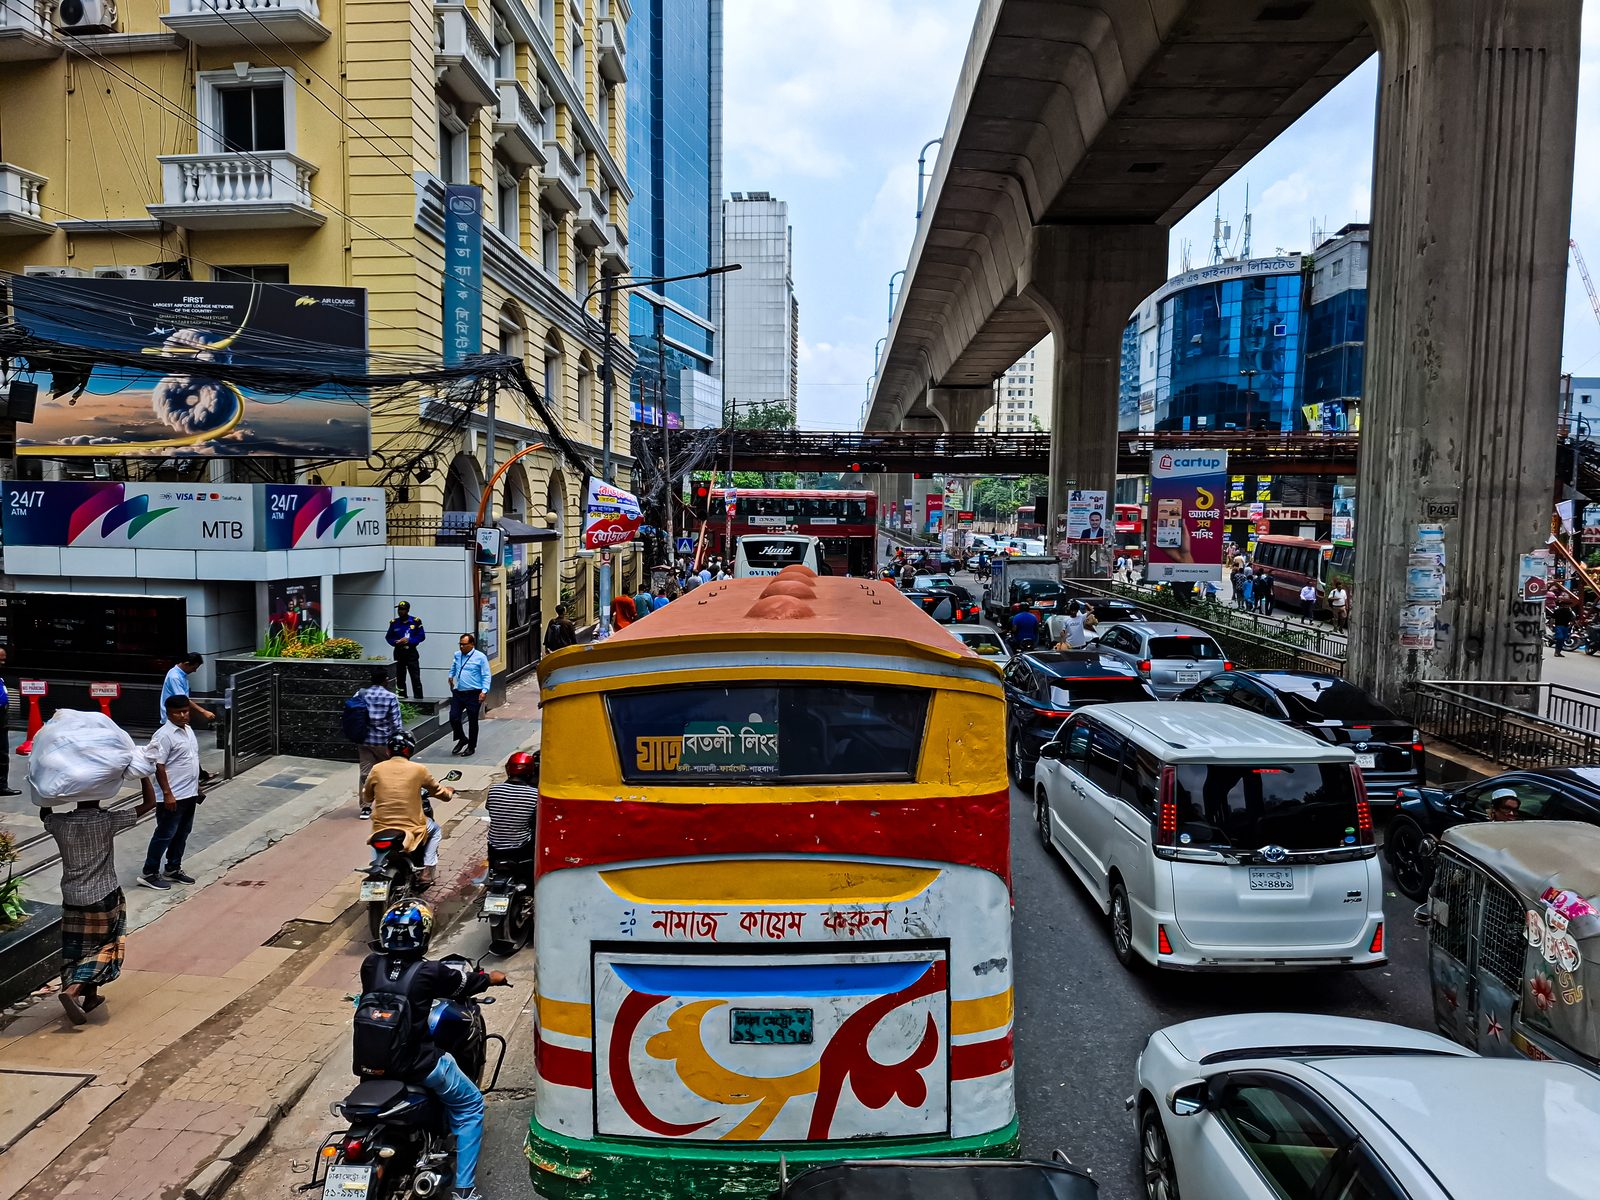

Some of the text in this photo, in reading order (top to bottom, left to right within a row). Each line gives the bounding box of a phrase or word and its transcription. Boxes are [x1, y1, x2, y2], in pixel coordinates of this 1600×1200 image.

[1247, 260, 1297, 272] লিমিটেড
[1174, 457, 1220, 469] cartup
[10, 491, 45, 508] 24/7
[175, 492, 194, 501] VISA
[270, 494, 298, 511] 24/7
[11, 508, 27, 516] ATM
[271, 512, 285, 520] ATM
[1188, 508, 1220, 519] অ্যাপেই
[1429, 505, 1457, 516] P491
[202, 520, 243, 539] MTB
[356, 520, 380, 536] MTB
[1191, 528, 1214, 539] শপিং
[758, 545, 795, 555] Hanif
[682, 725, 735, 755] াবতলী
[651, 908, 893, 942] নামাজ কায়েম করুন
